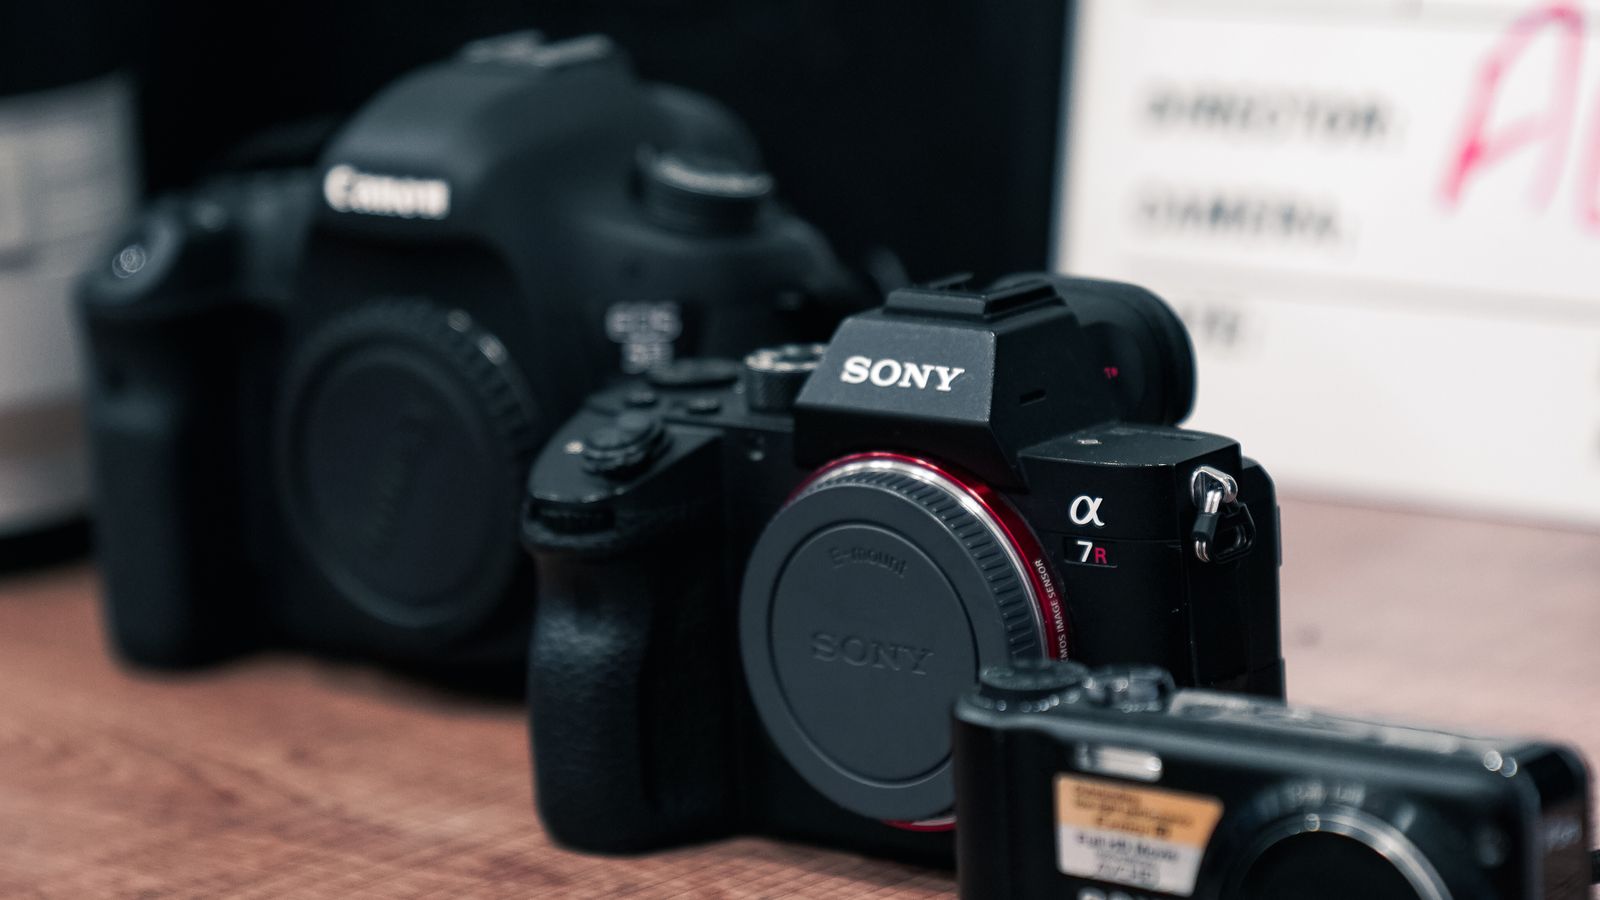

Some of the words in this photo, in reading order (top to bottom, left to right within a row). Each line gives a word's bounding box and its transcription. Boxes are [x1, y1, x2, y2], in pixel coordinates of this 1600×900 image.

[324, 165, 451, 219] Canon
[840, 355, 966, 392] SONY
[829, 546, 908, 579] E-mount
[1034, 559, 1057, 599] SENSOR
[1050, 600, 1065, 633] IMAGE
[811, 632, 936, 677] SONY
